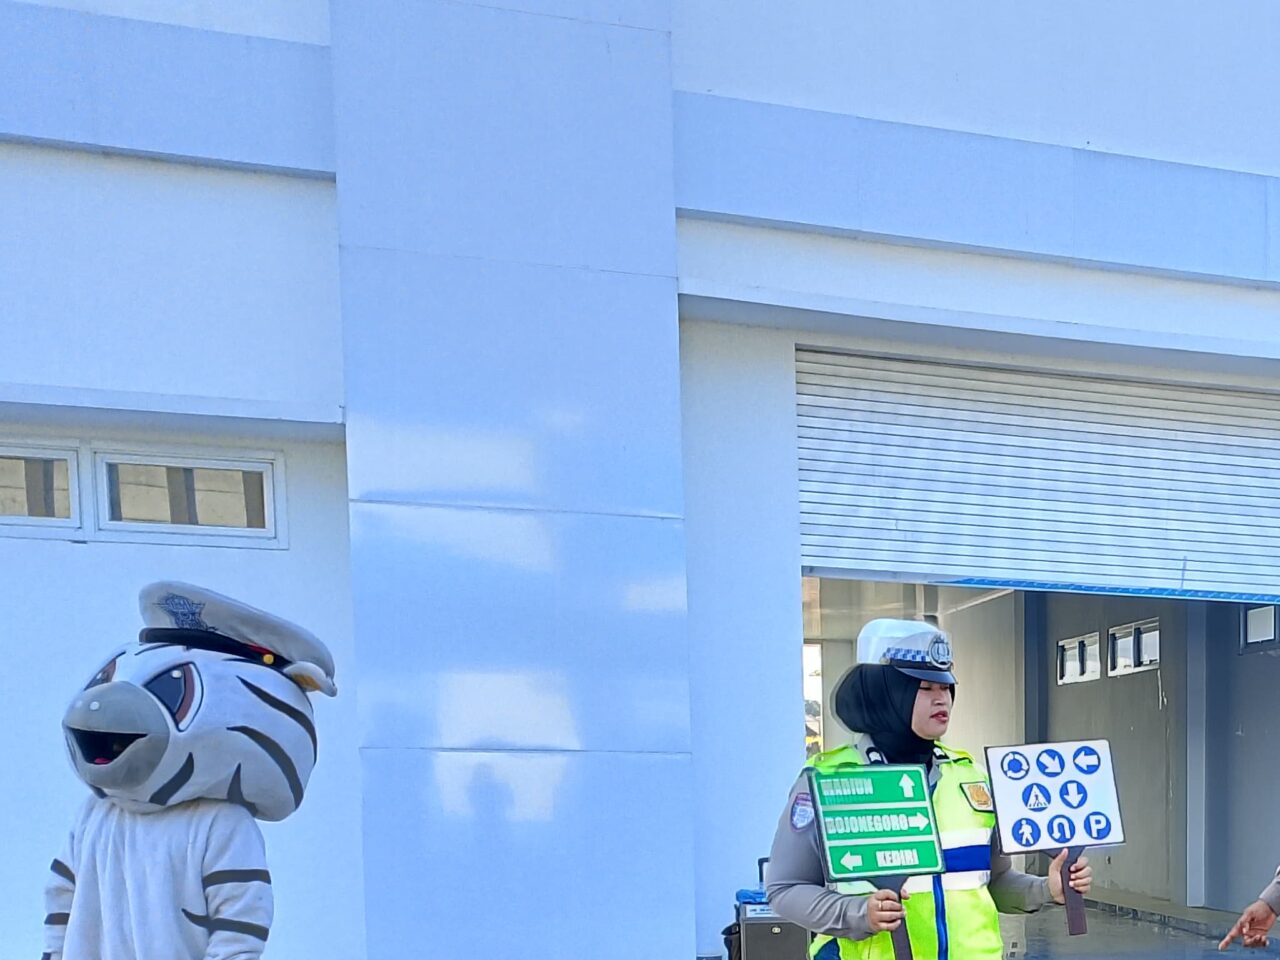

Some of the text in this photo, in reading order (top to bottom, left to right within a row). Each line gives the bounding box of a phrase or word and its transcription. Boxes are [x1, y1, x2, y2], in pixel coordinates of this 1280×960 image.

[825, 814, 908, 834] BOJONEGORO
[1089, 815, 1107, 838] P
[876, 848, 919, 867] KEDIRI
